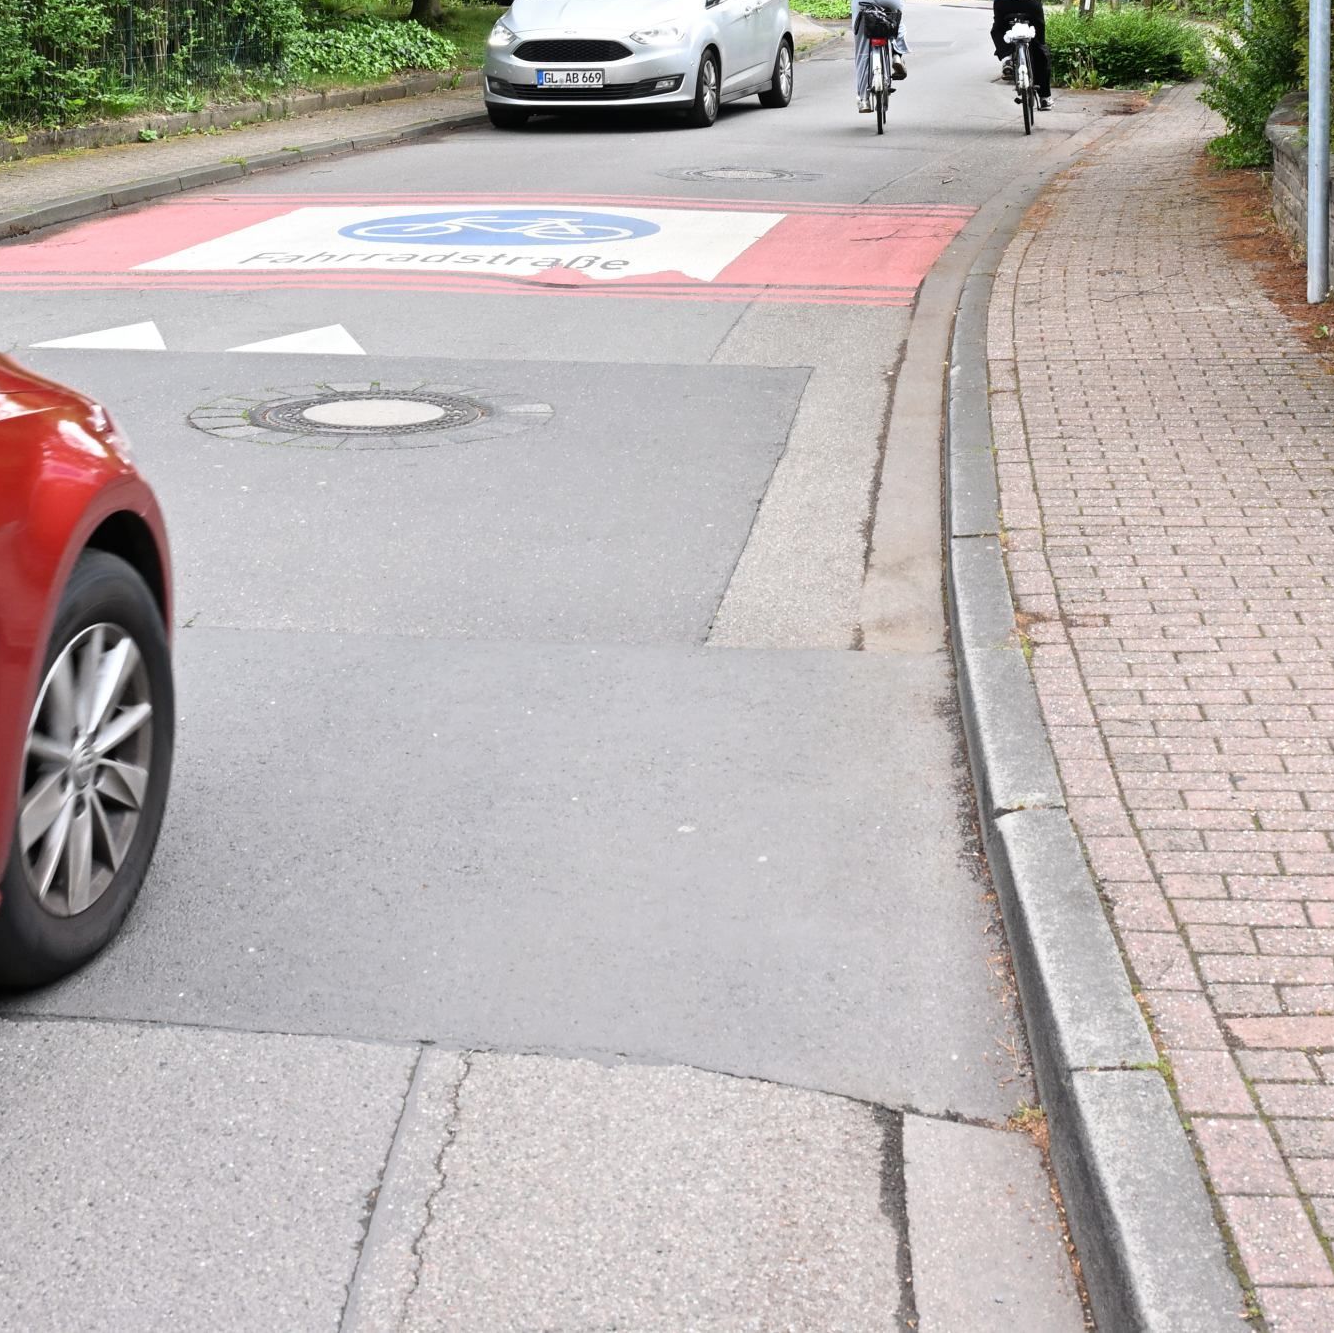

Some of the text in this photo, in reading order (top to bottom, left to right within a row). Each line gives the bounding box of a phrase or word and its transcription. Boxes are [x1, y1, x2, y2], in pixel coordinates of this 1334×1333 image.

[544, 72, 602, 83] GL AB 669
[238, 251, 630, 271] Fahrradstraße
